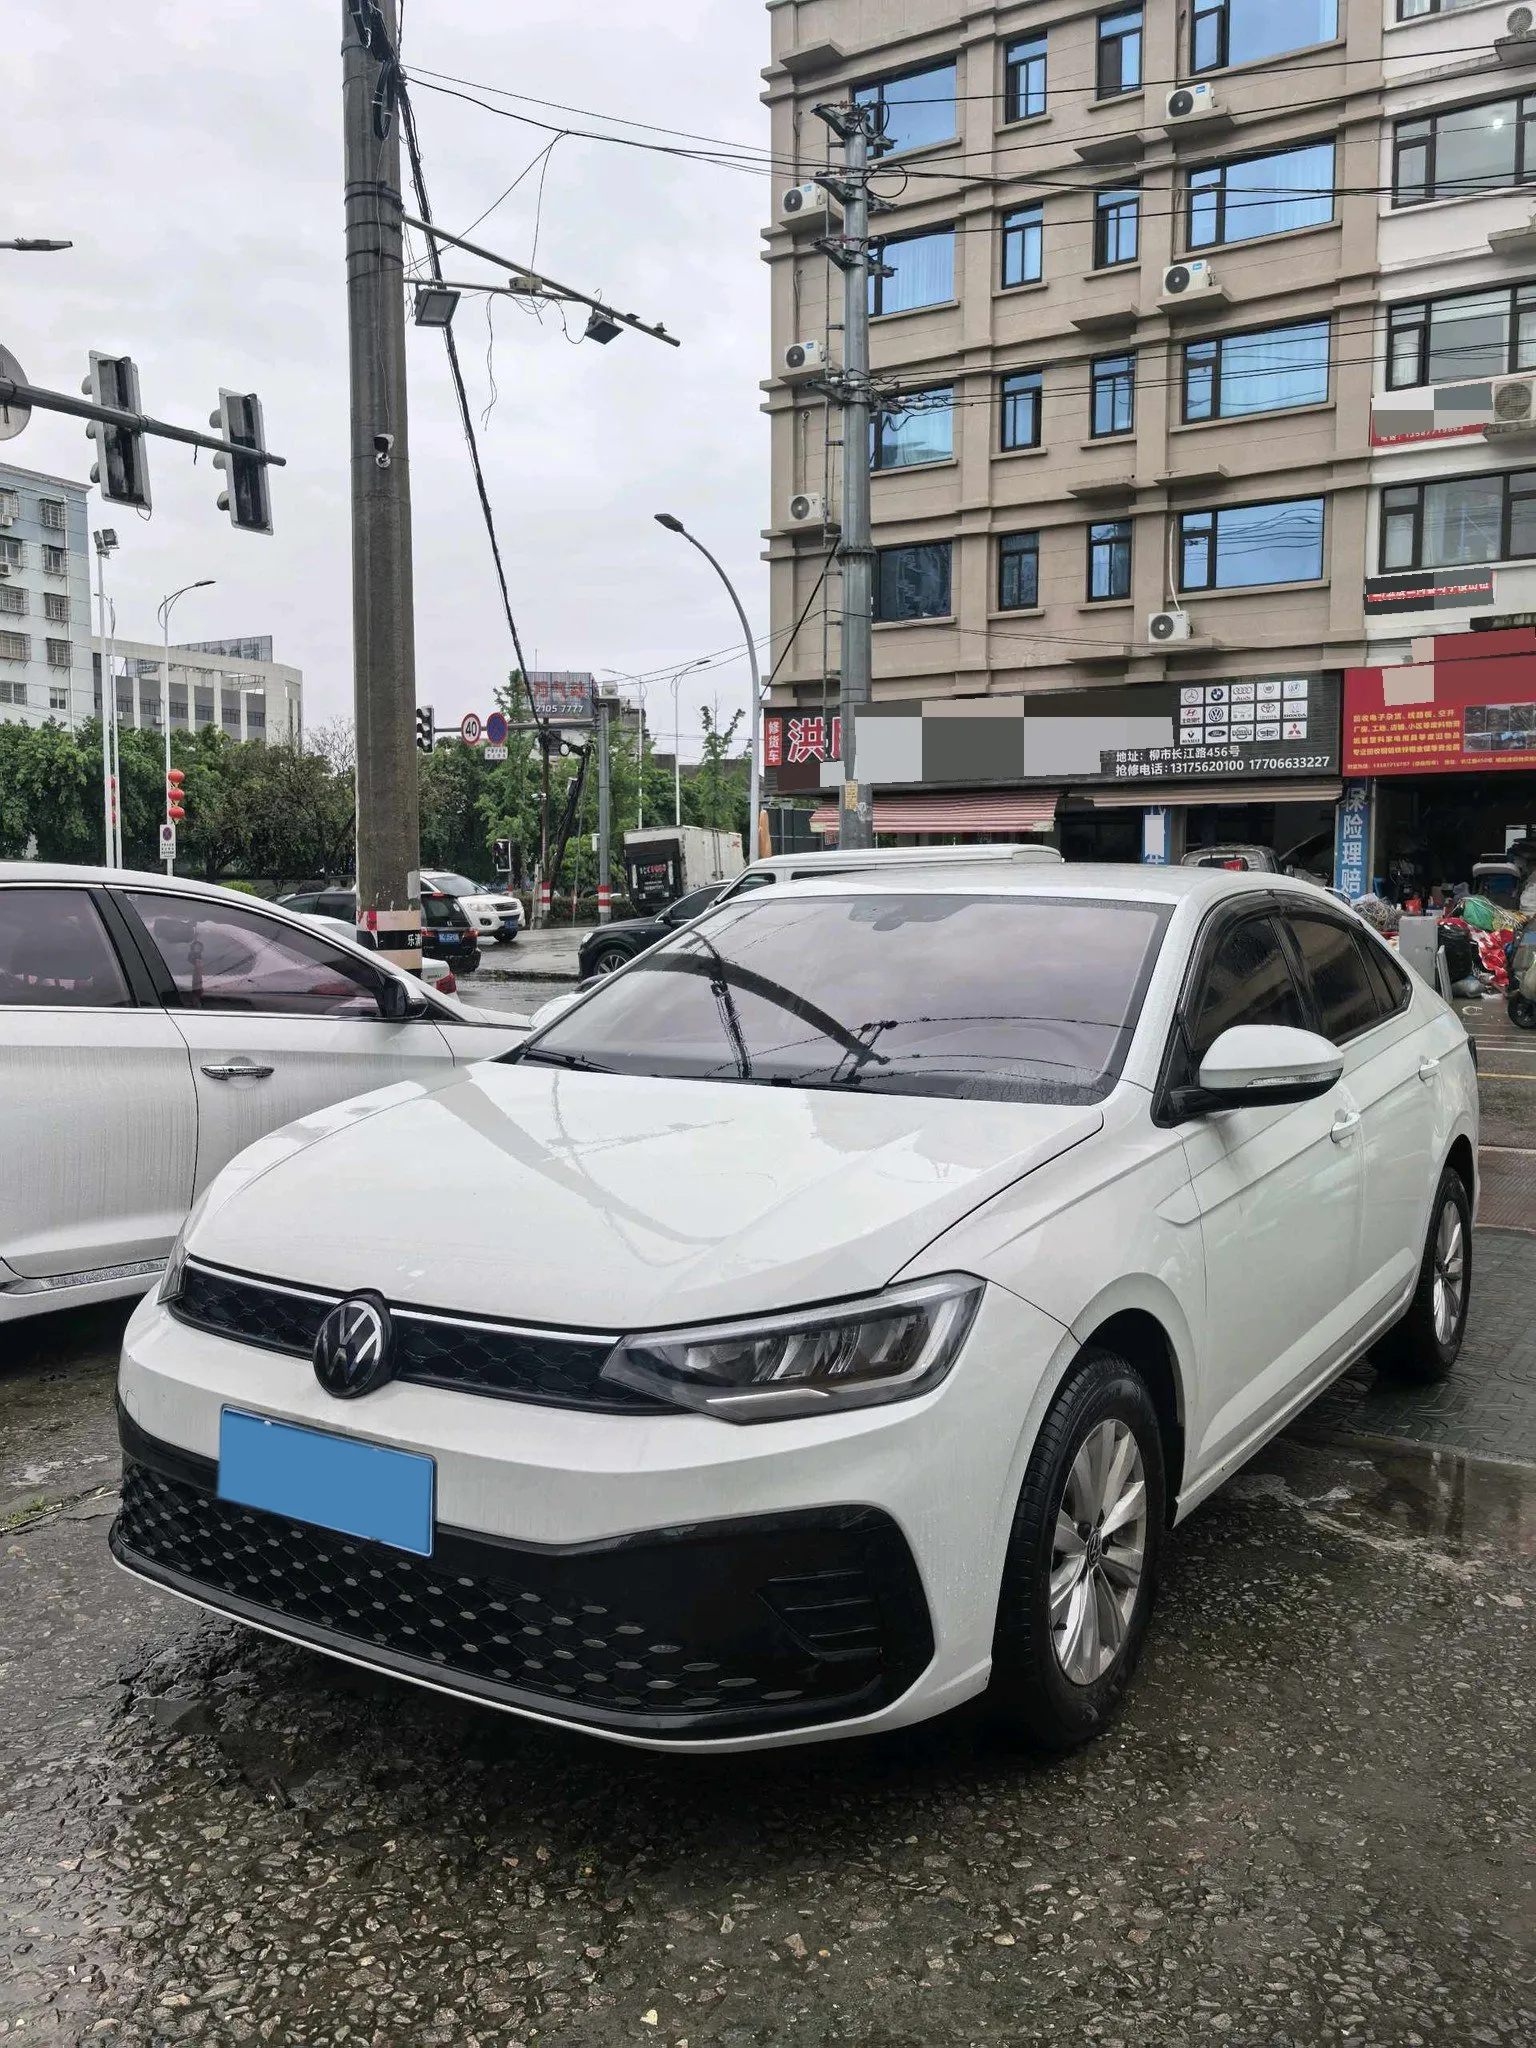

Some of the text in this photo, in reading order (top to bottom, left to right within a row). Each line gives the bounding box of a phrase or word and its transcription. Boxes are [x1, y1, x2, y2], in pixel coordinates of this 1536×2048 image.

[536, 705, 584, 713] 2105 7777
[465, 721, 477, 737] 40
[768, 721, 780, 762] 修货车
[787, 716, 841, 763] 洪
[1249, 756, 1330, 770] 17706633227
[1340, 787, 1366, 894] 保险理赔
